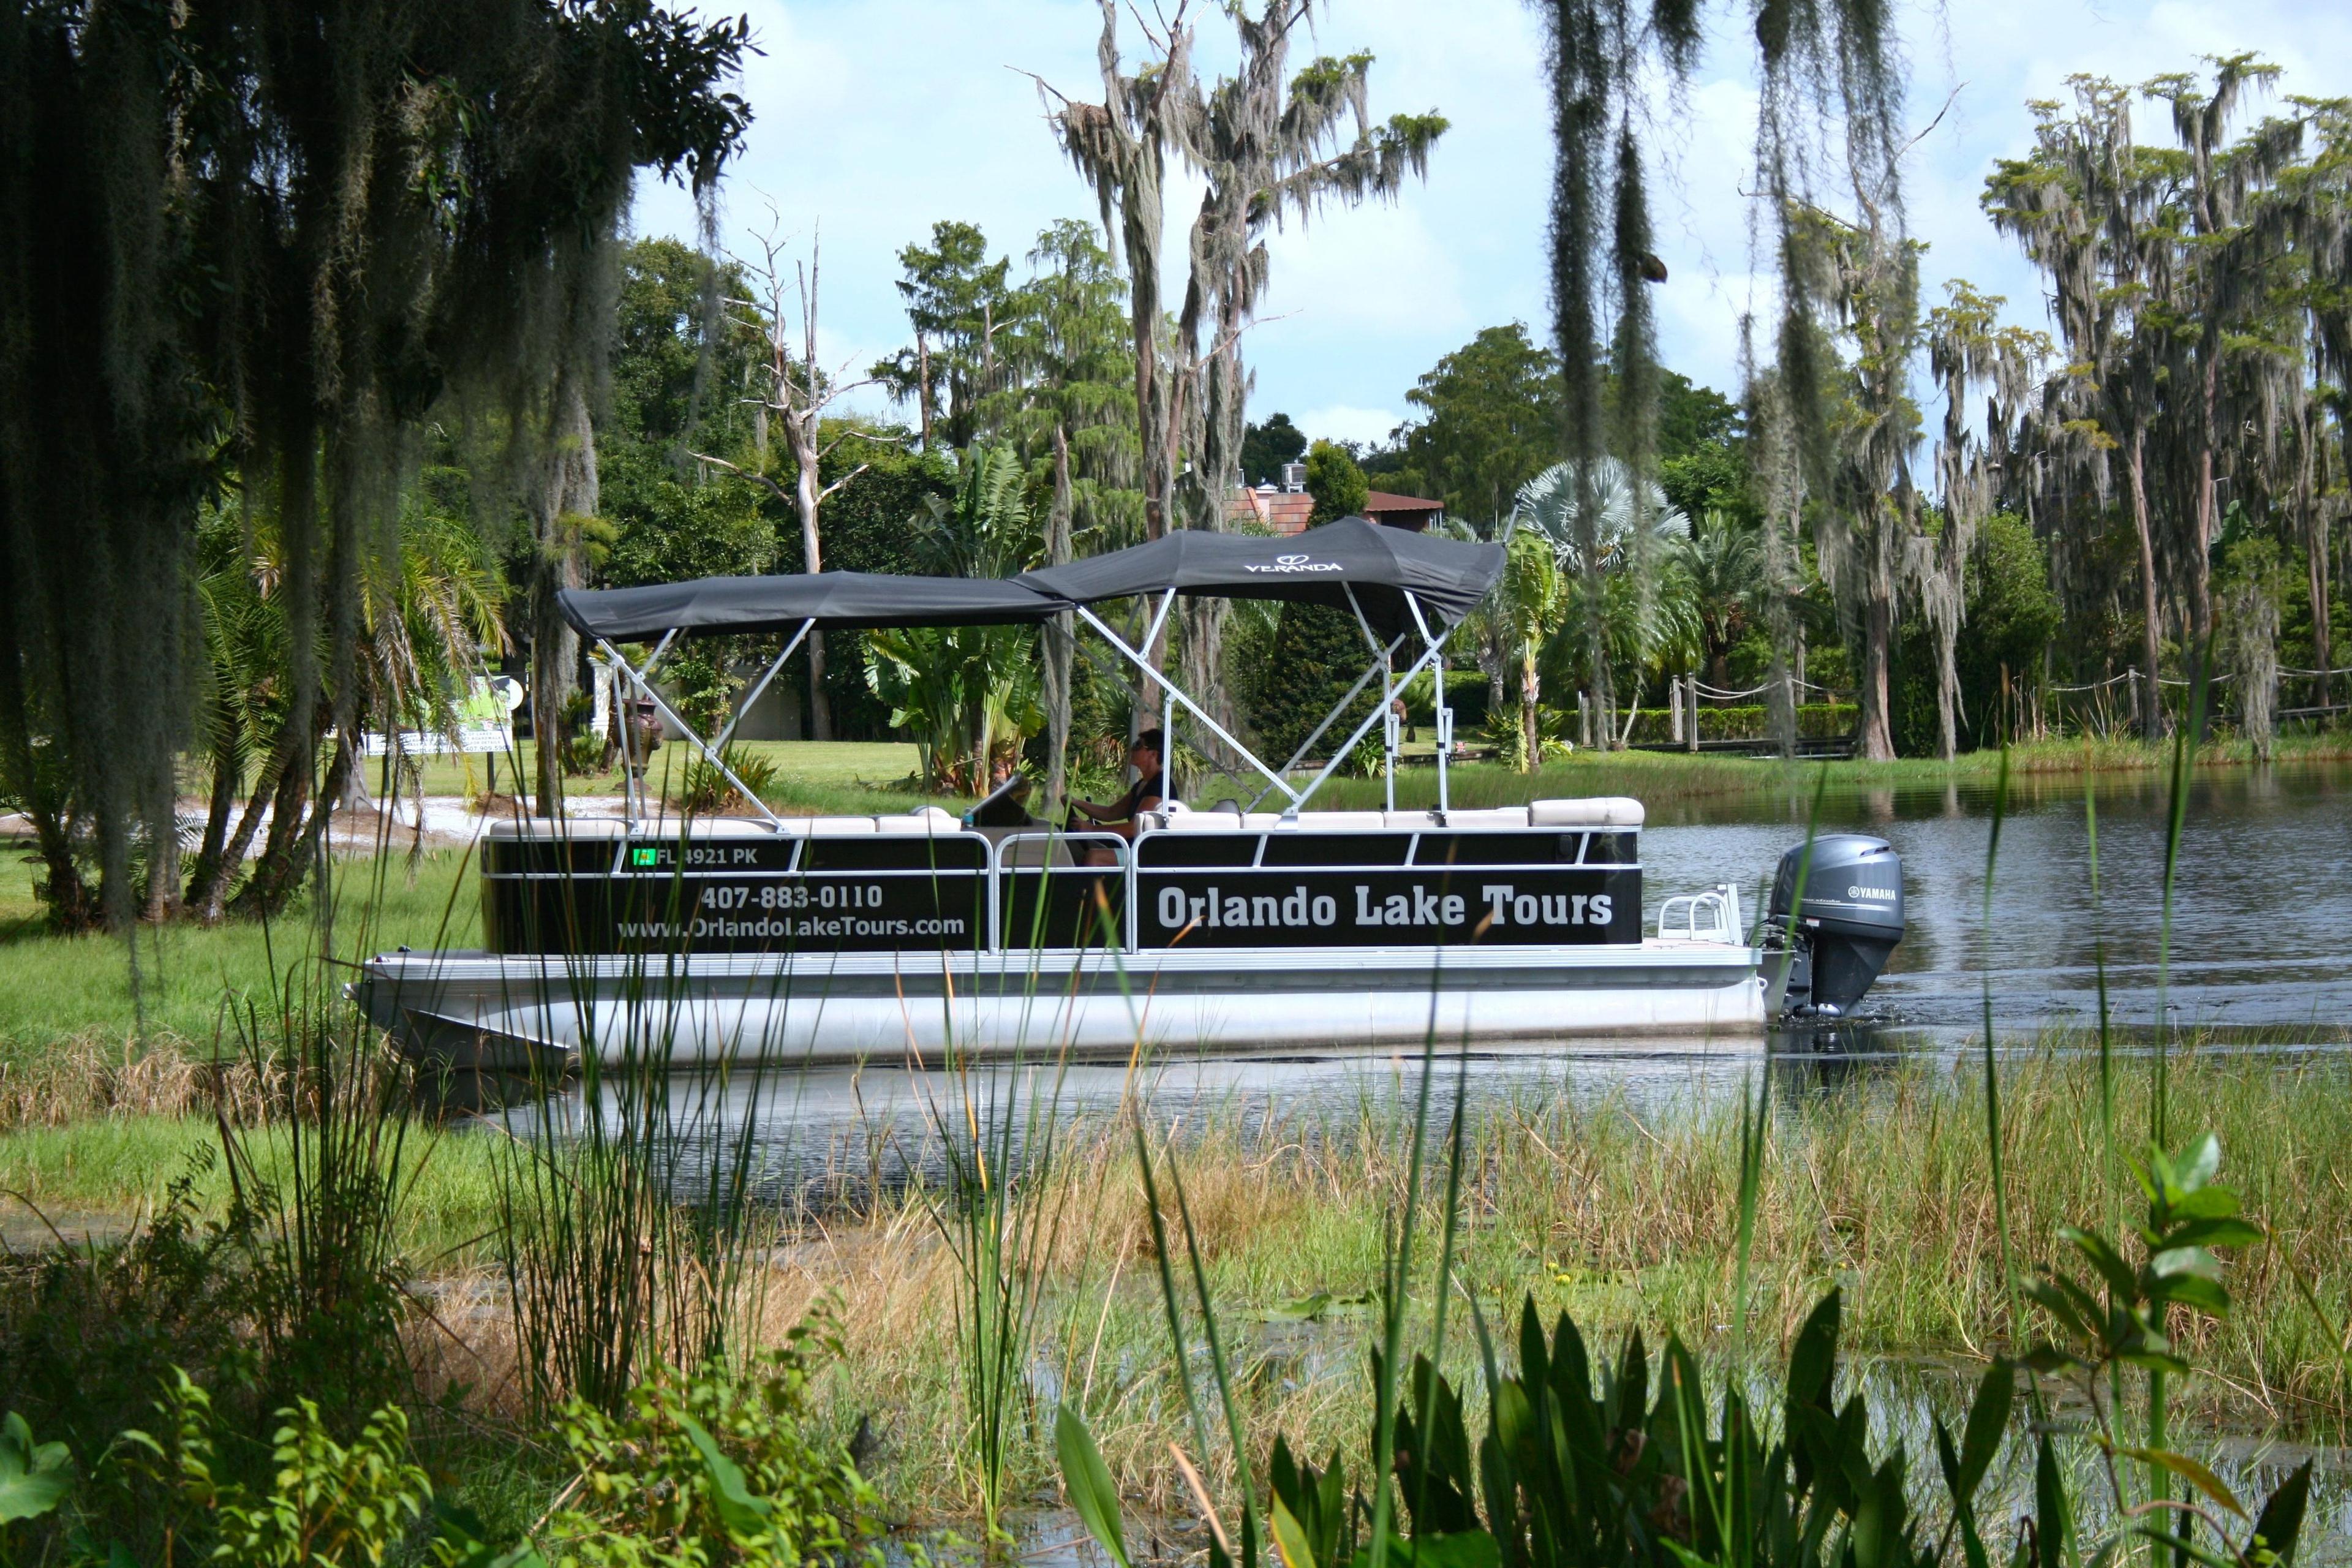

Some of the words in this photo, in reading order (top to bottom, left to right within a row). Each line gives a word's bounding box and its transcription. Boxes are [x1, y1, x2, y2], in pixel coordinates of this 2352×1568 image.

[1244, 563, 1344, 573] VERANDA
[657, 849, 677, 864] FL
[683, 848, 728, 864] 4921
[733, 848, 758, 864] PK
[701, 886, 883, 908] 407-883-0110
[1861, 888, 1896, 900] YAMAHA
[1158, 886, 1336, 928] Orlando
[1355, 885, 1466, 925] Lake
[1483, 884, 1612, 925] Tours
